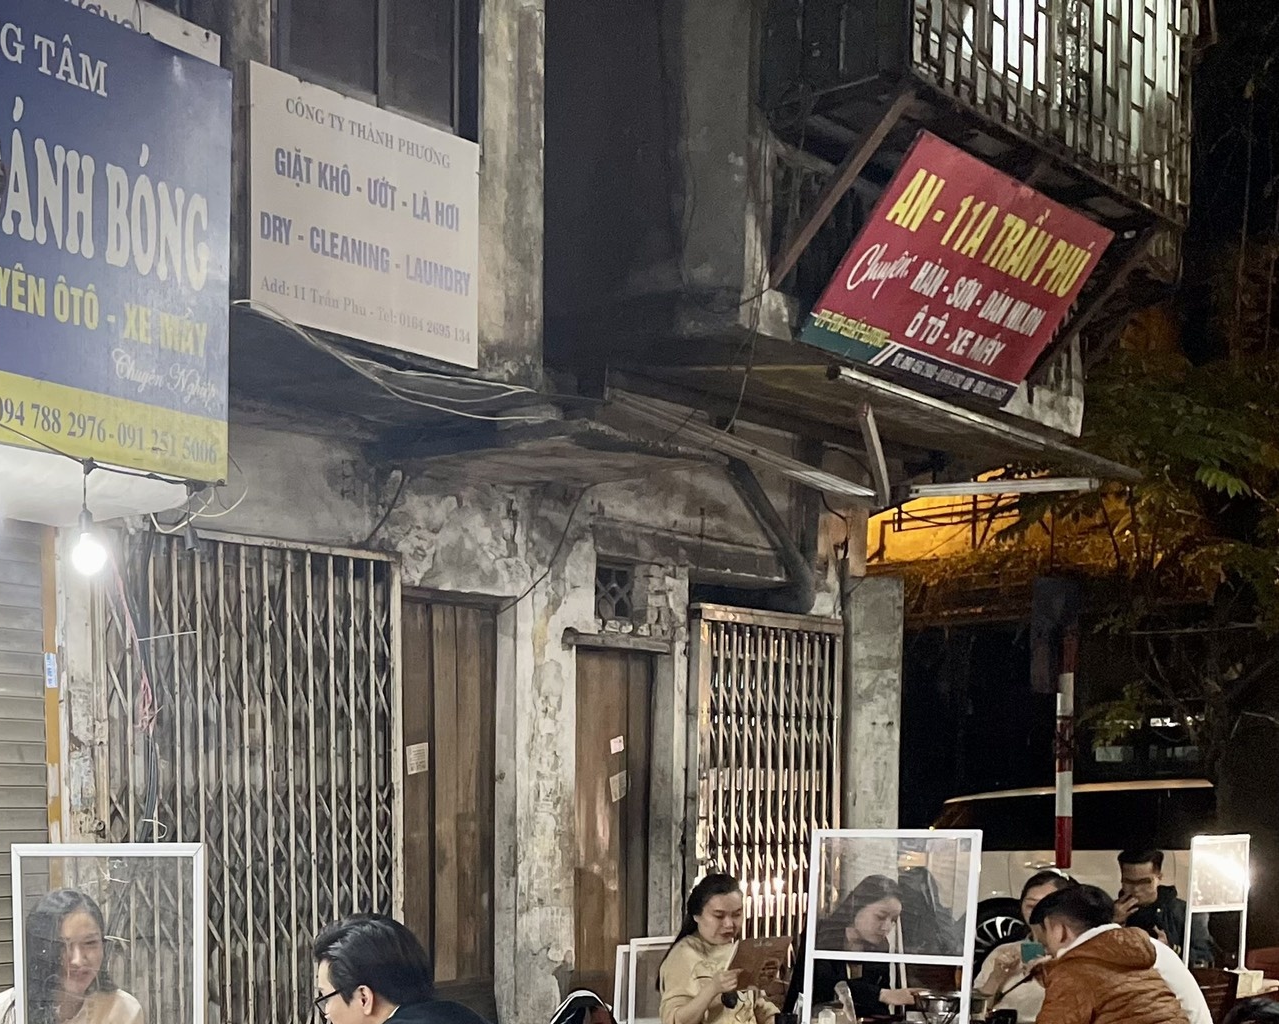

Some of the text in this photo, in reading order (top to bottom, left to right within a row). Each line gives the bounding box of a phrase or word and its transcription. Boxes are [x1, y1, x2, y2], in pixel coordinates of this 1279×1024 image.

[34, 34, 108, 97] TÂM
[286, 97, 325, 124] CÔNG
[328, 113, 345, 131] TY
[106, 143, 210, 291] BÓNG
[275, 146, 313, 187] GIẶT
[318, 164, 351, 197] KHÔ
[435, 200, 460, 232] HƠI
[260, 211, 292, 245] DRY
[310, 227, 390, 273] CLEANING
[406, 254, 471, 296] LAUNDRY
[885, 168, 946, 232] AN
[1032, 241, 1096, 298] PHÚ
[54, 275, 99, 330] ÔTÔ
[124, 302, 152, 345] XE
[261, 276, 289, 296] Add:
[946, 327, 976, 355] XE
[31, 404, 61, 433] 788
[67, 412, 106, 442] 2976
[118, 422, 144, 451] 091
